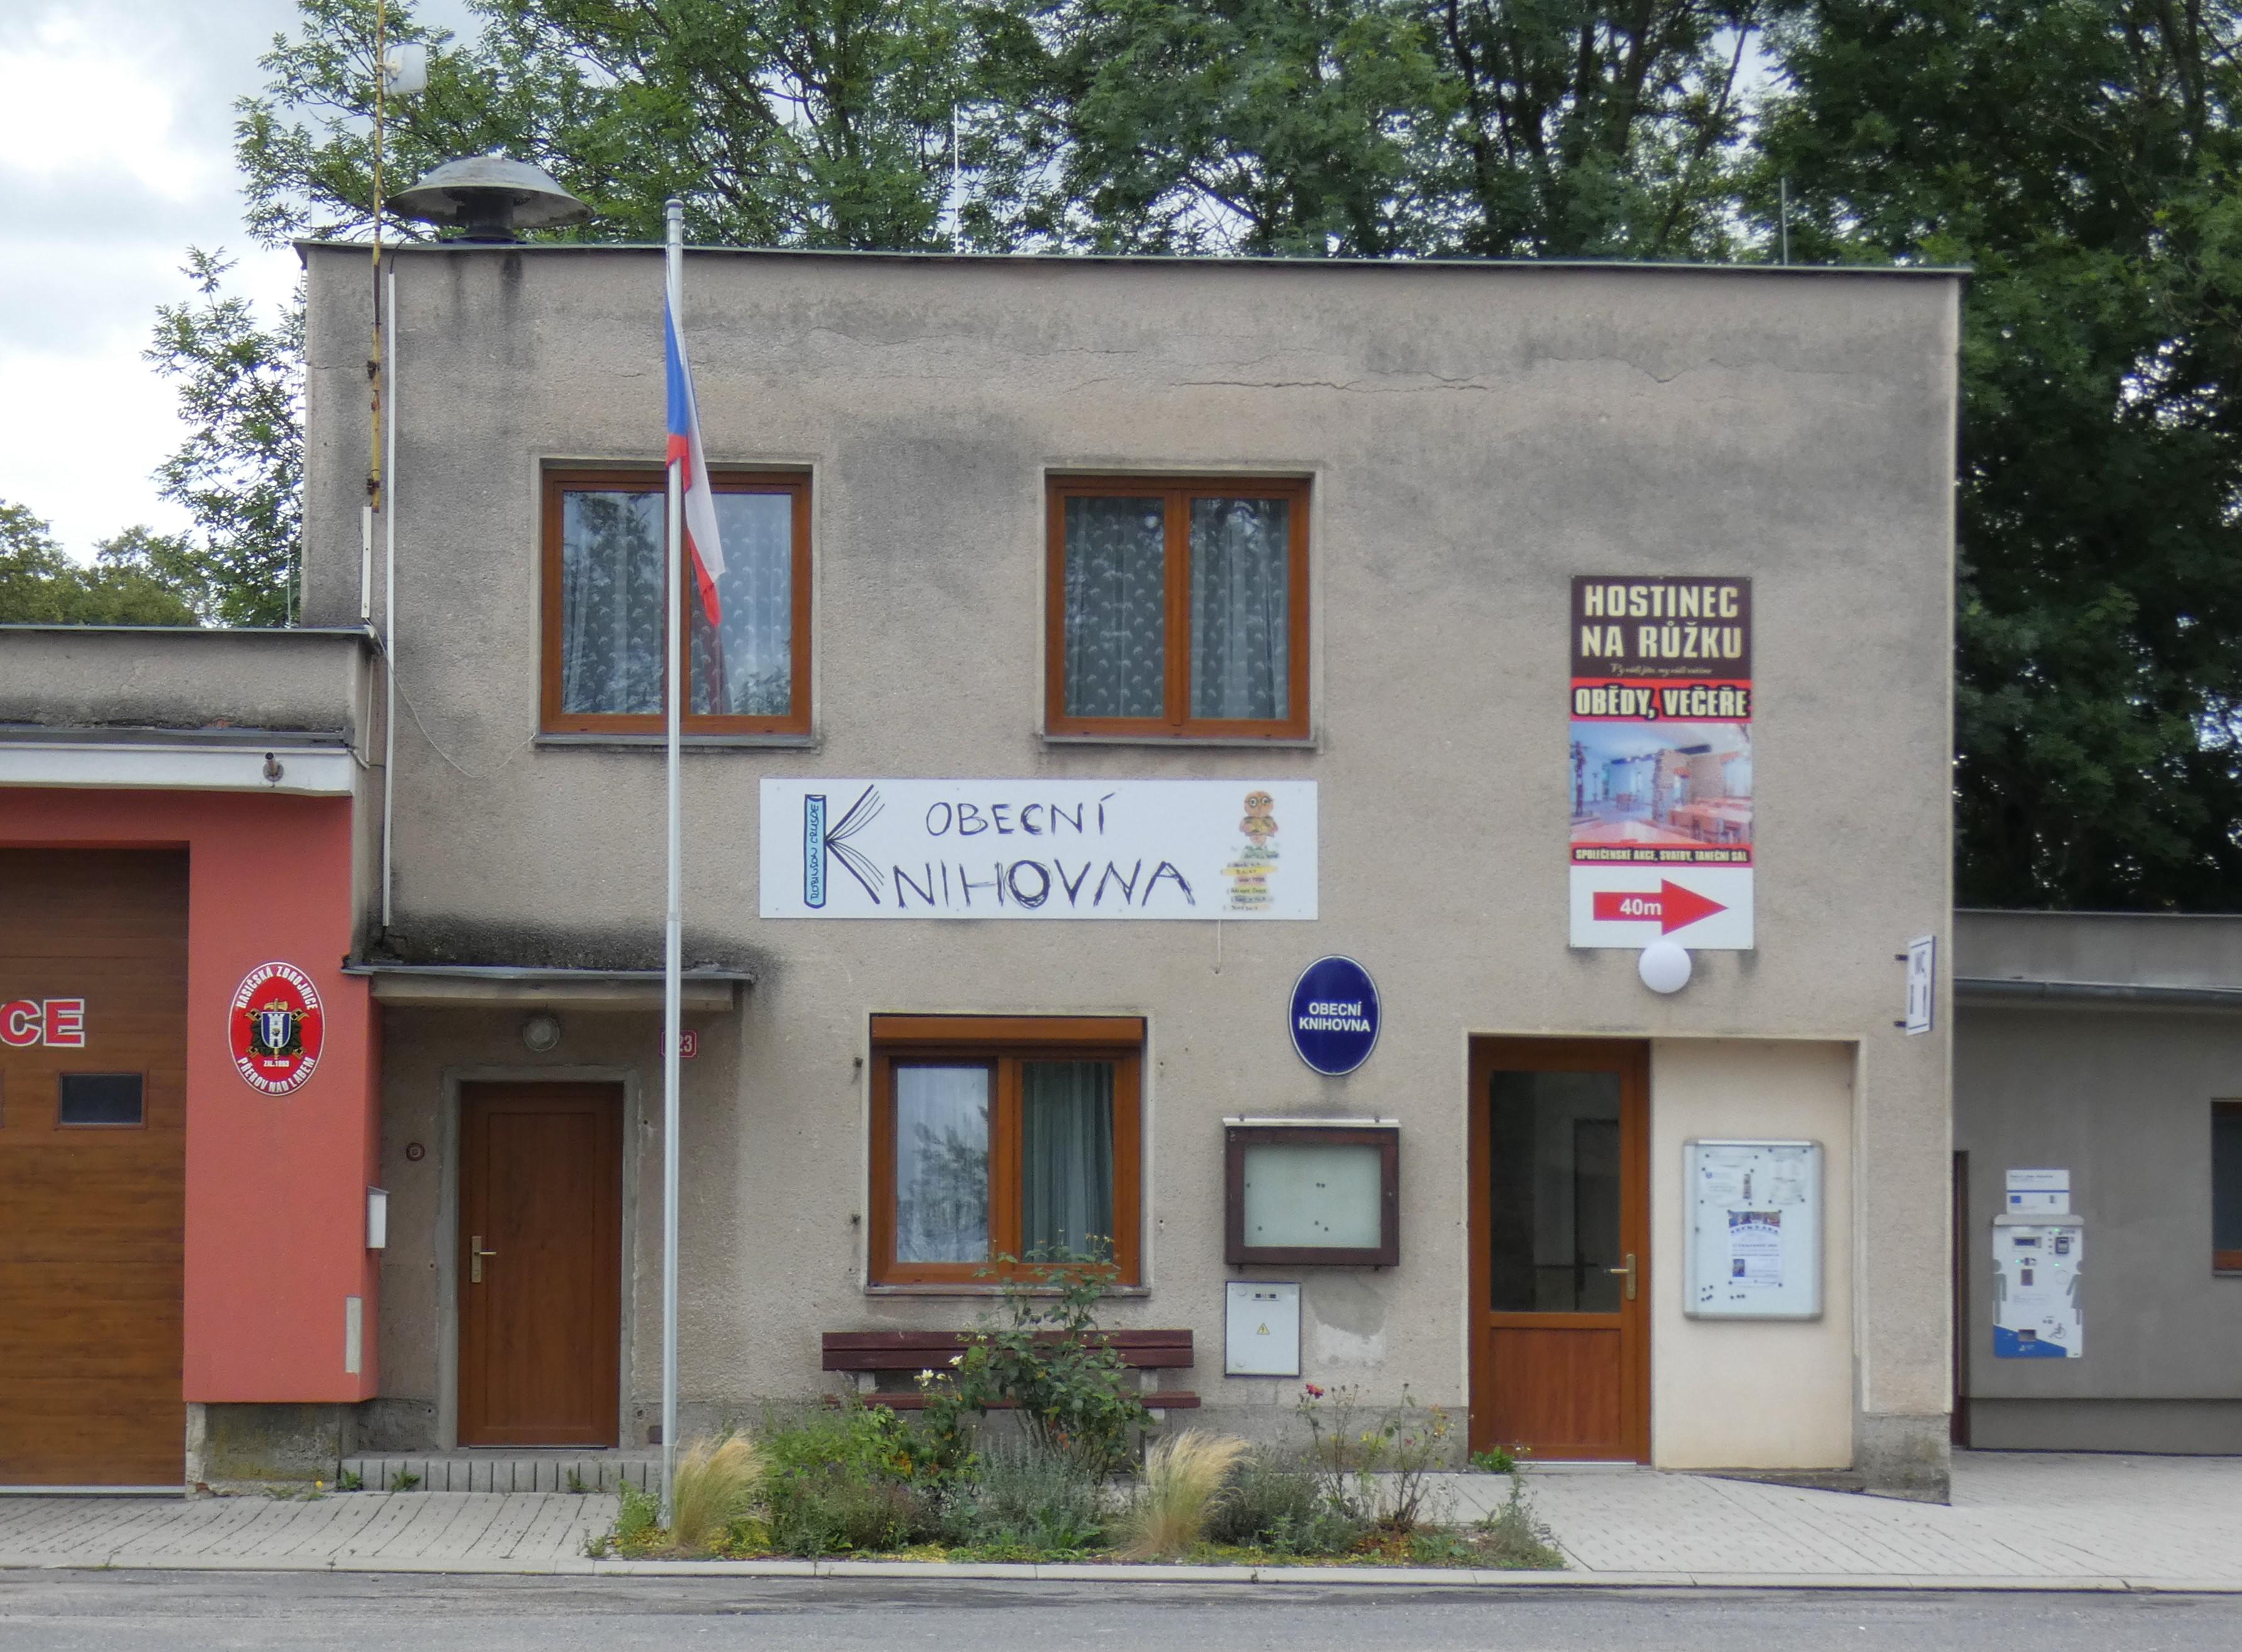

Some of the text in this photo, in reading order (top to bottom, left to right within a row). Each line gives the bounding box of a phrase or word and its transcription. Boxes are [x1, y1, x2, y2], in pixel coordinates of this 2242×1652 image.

[1584, 585, 1739, 618] HOSTINEC
[1581, 620, 1742, 659] NA RŮŽKU
[1575, 685, 1747, 719] OBĚDY, VEČEŘE
[809, 804, 819, 844] CRUSOE
[926, 792, 1116, 836] OBECNÍ
[1620, 899, 1662, 916] 40m
[236, 966, 318, 1010] HASIČSKÁ ZBROJNICE
[1299, 1017, 1370, 1032] KNIHOVNA
[1309, 1001, 1362, 1016] OBECNÍ
[238, 1056, 315, 1093] PŘEROV NAD LABEM
